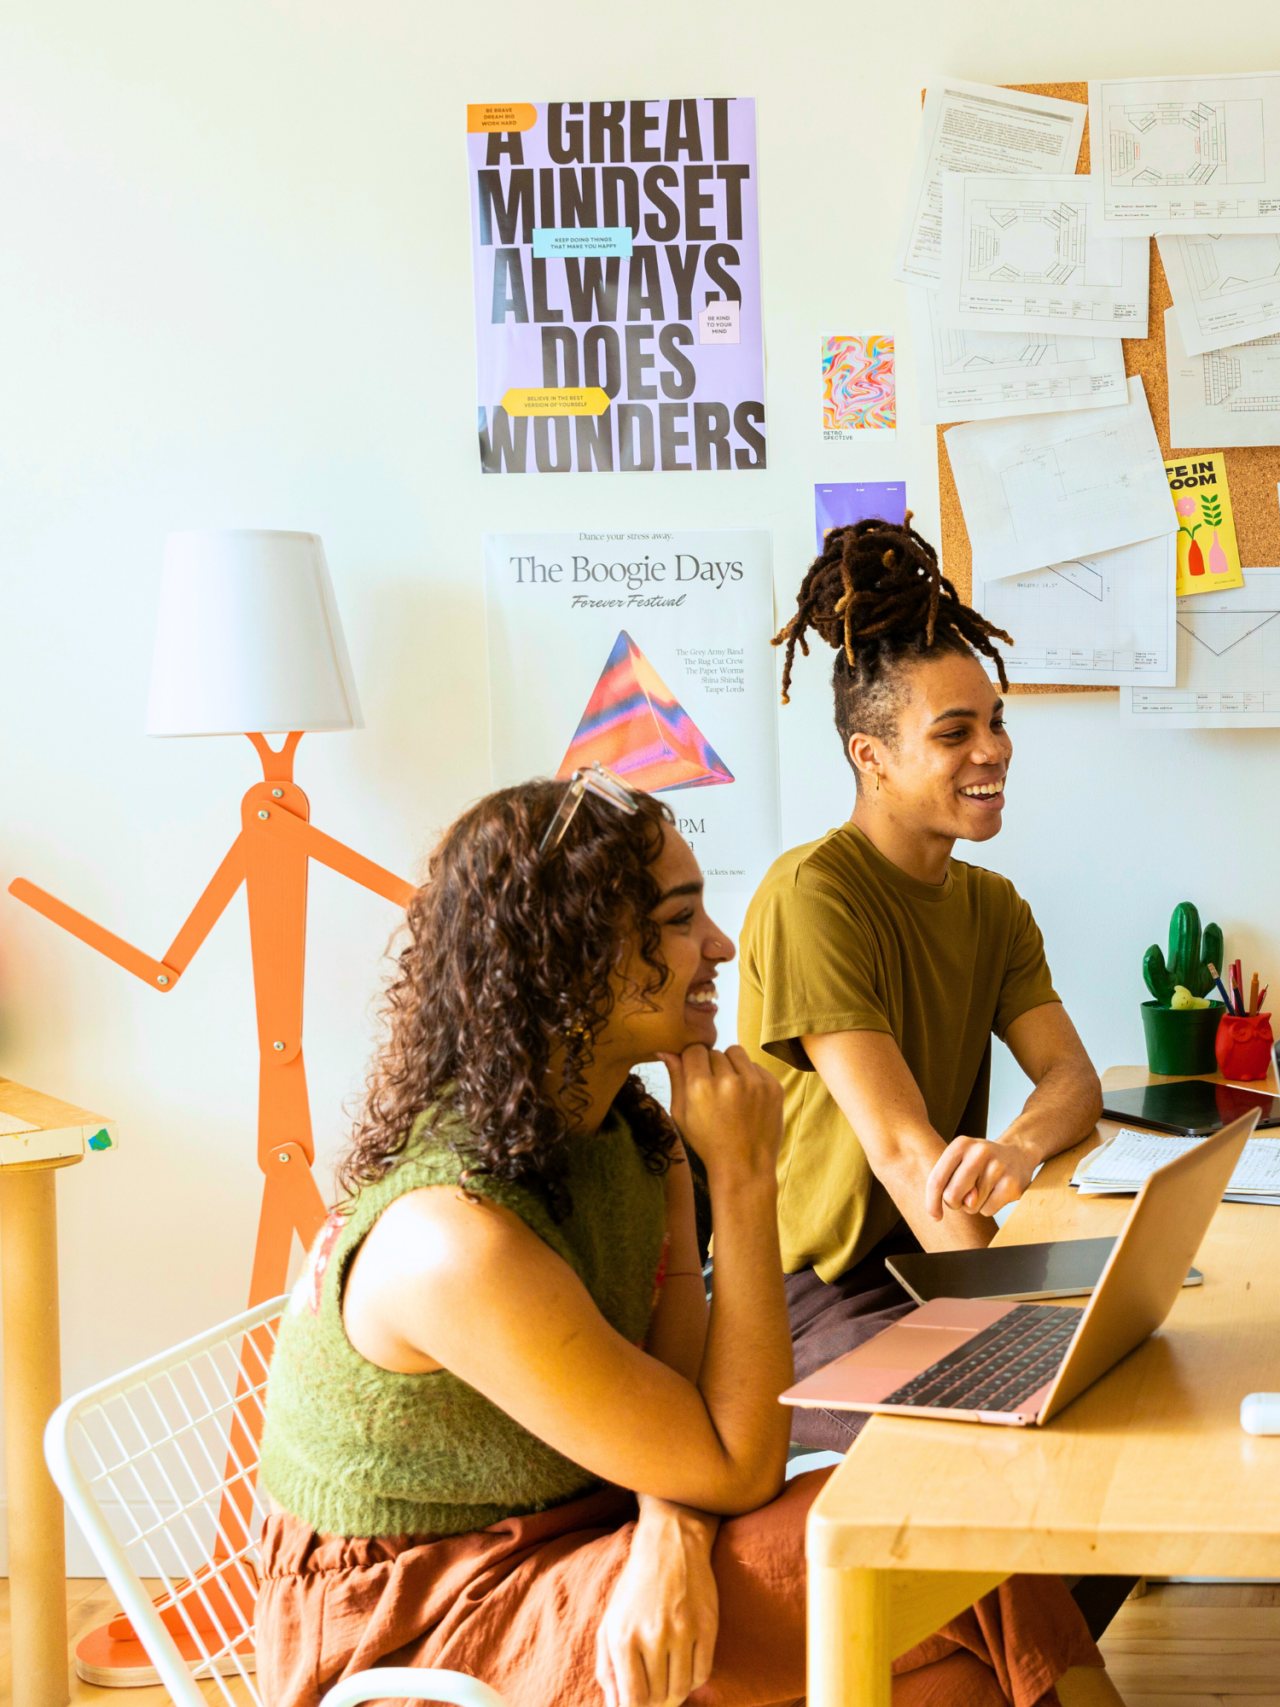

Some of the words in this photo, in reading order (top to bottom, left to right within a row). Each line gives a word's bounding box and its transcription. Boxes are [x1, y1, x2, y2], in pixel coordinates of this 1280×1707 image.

[547, 98, 737, 164] GREAT
[478, 165, 750, 245] MINDSET
[491, 243, 742, 324] ALWAYS
[541, 323, 696, 401] DOES
[478, 401, 766, 473] WONDERS
[1192, 461, 1214, 474] IN
[1169, 473, 1217, 490] OOM
[578, 532, 604, 541] Dance
[605, 534, 625, 543] your
[626, 533, 649, 541] stress
[651, 533, 674, 543] away.
[510, 555, 563, 584] The
[571, 554, 667, 590] Boogie
[674, 554, 744, 589] Days
[571, 595, 626, 609] Forever
[626, 593, 687, 608] Festival
[676, 648, 689, 656] The
[690, 648, 706, 657] Grey
[707, 648, 726, 657] Army
[698, 658, 711, 666] Rug
[726, 657, 744, 665] Crew
[685, 667, 698, 675] The
[699, 667, 718, 676] Paper
[701, 676, 719, 684] Shina
[720, 676, 745, 685] Shindig
[705, 686, 725, 695] Taupe
[726, 686, 745, 694] Lords
